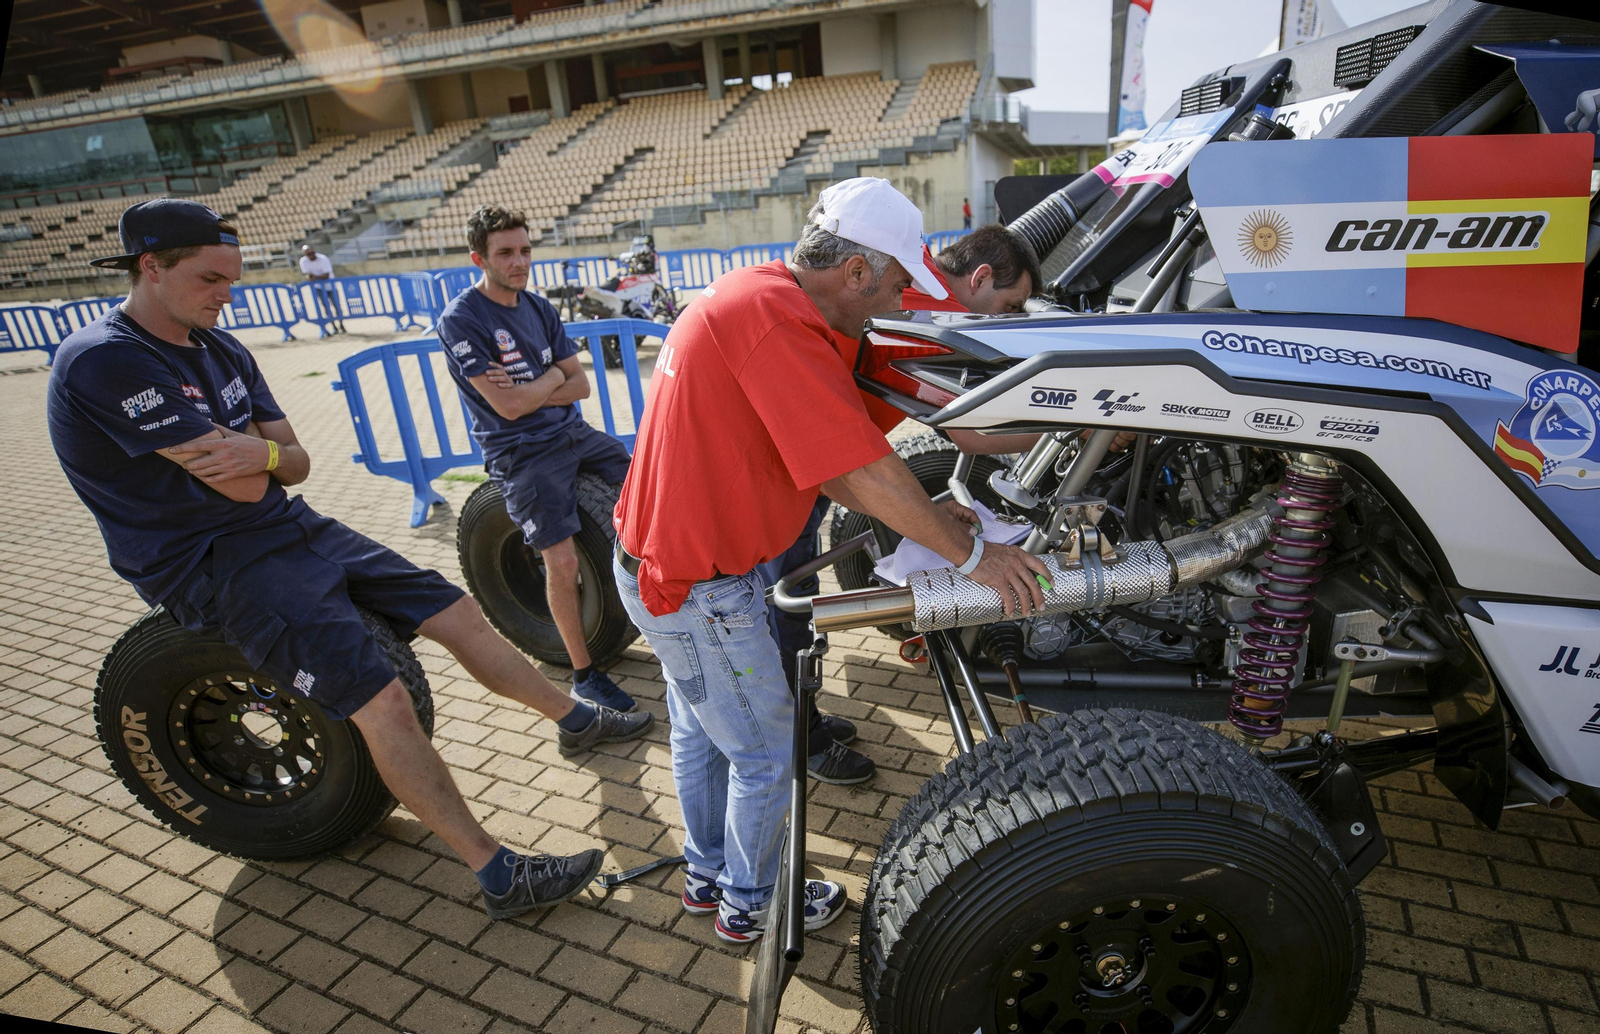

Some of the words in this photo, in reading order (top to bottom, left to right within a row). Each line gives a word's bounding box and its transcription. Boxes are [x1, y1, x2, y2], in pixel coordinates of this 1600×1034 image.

[1144, 139, 1194, 171] 306
[1325, 215, 1545, 252] can-am
[1203, 331, 1491, 390] conarpesa.com.ar
[121, 387, 156, 412] SOUTH
[1031, 390, 1077, 406] OMP
[1161, 403, 1189, 414] SBK
[1197, 408, 1229, 418] MOTUL
[1252, 412, 1296, 427] BELL
[1324, 415, 1363, 423] DESIGN
[1324, 422, 1376, 433] SPORT
[121, 705, 208, 826] TENSOR
